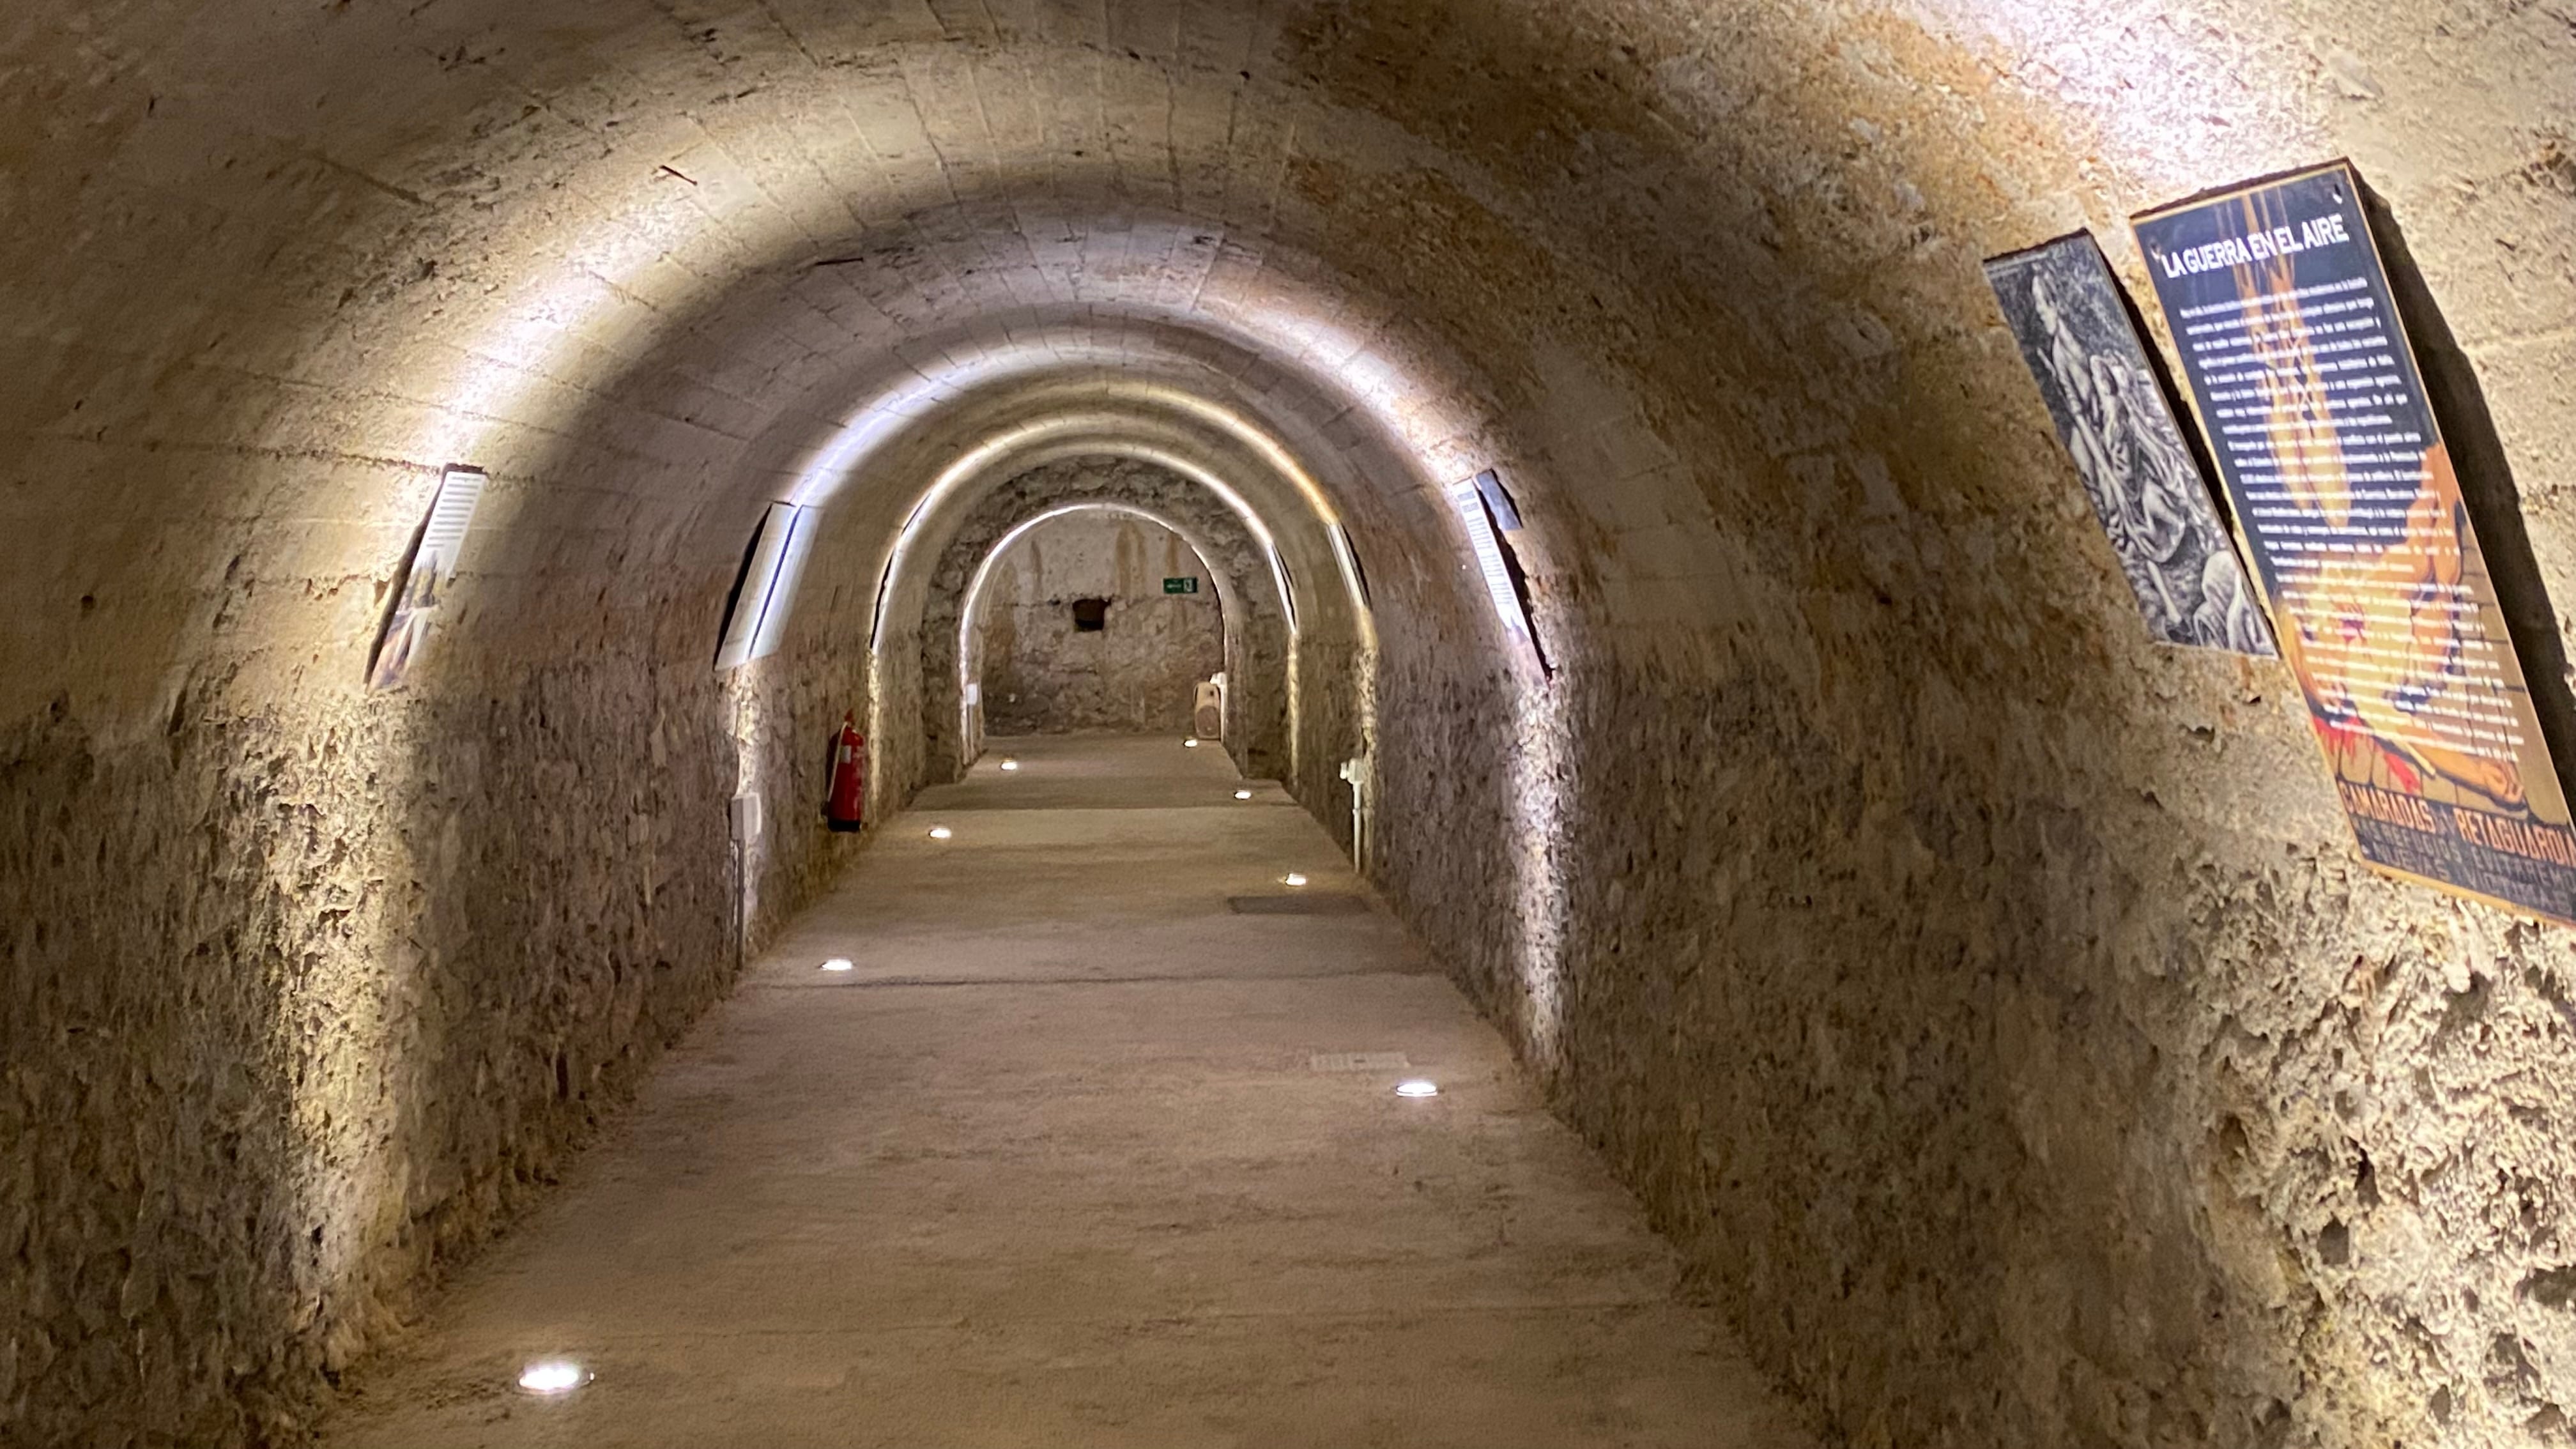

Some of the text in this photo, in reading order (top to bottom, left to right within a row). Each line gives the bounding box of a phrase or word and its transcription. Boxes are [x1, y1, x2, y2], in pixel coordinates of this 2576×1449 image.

[2161, 213, 2349, 278] LA GUERRA EN EL AIRE
[2338, 780, 2437, 834] CAMARADAS
[2453, 807, 2576, 869] RETAGUARDIA
[2379, 822, 2463, 864] REFUGIOS
[2470, 845, 2576, 894] EVITAREMO
[2372, 841, 2451, 882] NUEVAS
